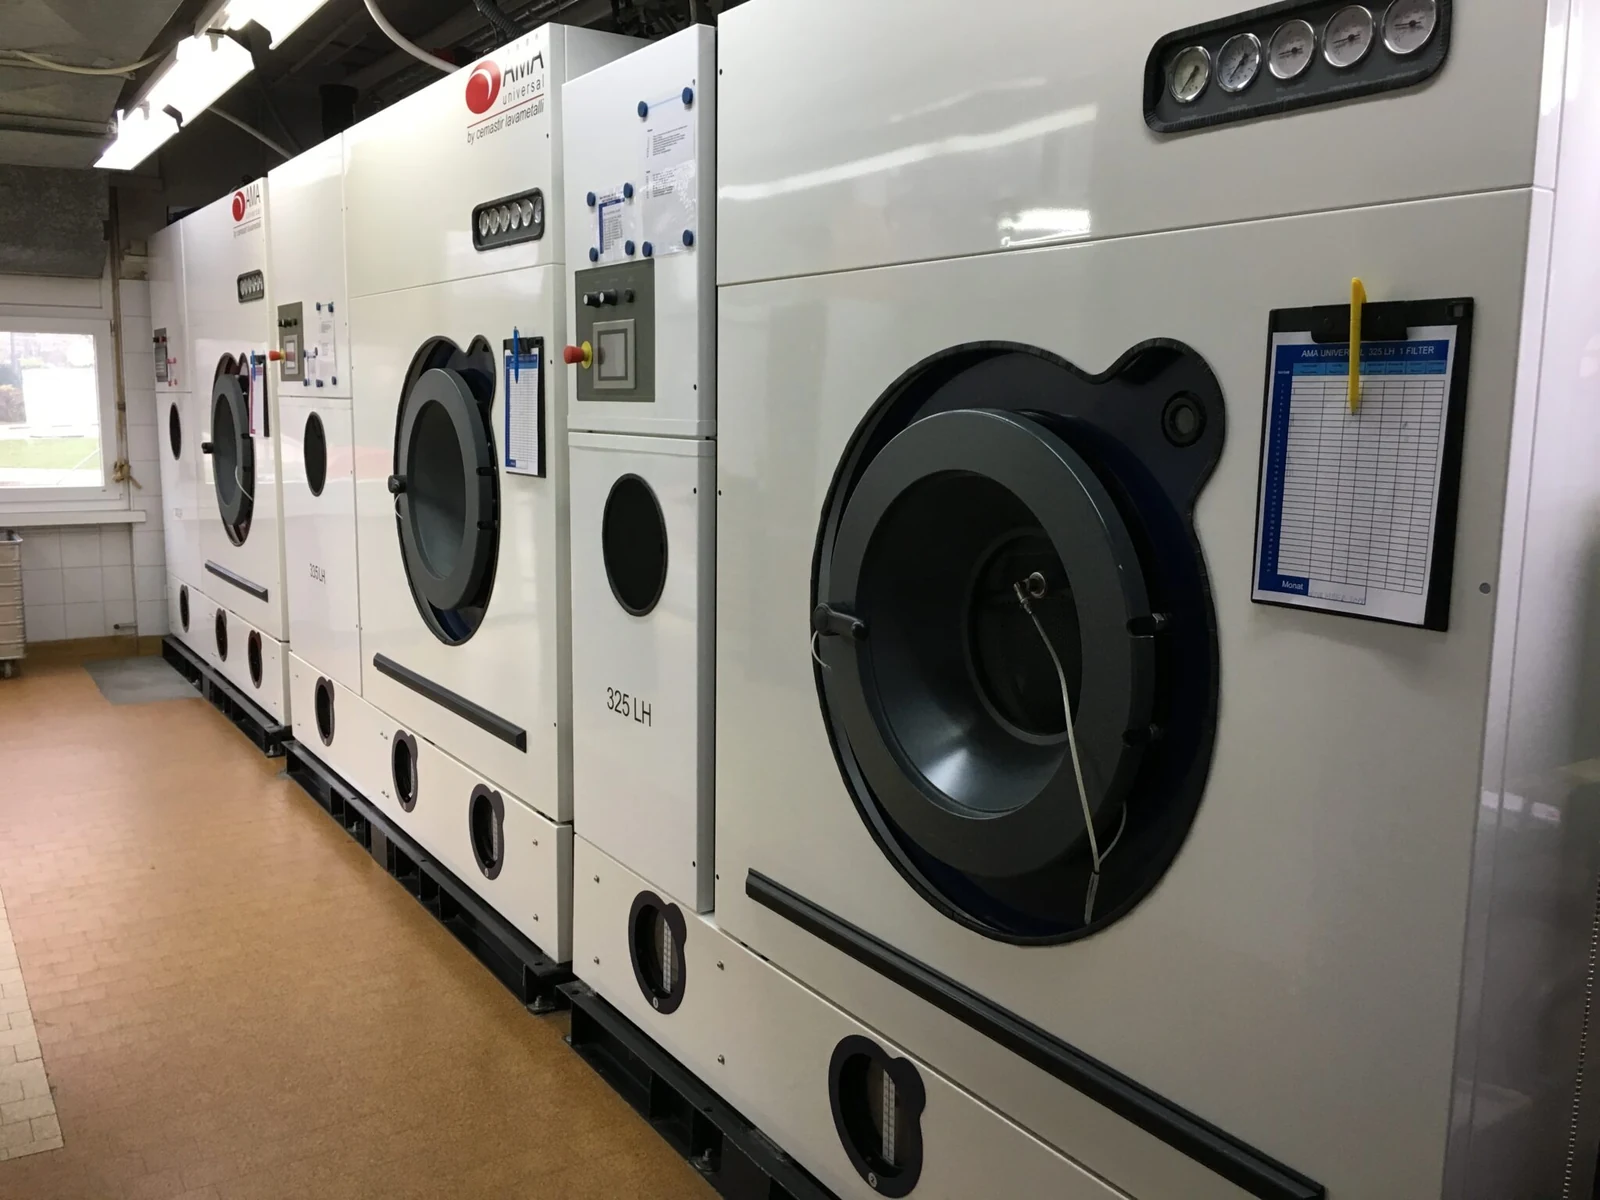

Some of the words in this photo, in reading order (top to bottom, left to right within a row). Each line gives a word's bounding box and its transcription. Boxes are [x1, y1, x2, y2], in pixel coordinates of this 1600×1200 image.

[502, 74, 544, 105] universal
[467, 130, 476, 145] by
[476, 117, 504, 139] cemastir
[505, 98, 544, 127] lavametalli
[1301, 349, 1319, 358] AMA
[1320, 347, 1365, 358] UNIVERL
[1369, 347, 1382, 356] 325
[1384, 347, 1396, 356] LH
[1406, 345, 1435, 355] FILTER
[1282, 580, 1304, 590] Monat
[607, 686, 630, 717] 325
[634, 697, 652, 727] LH
